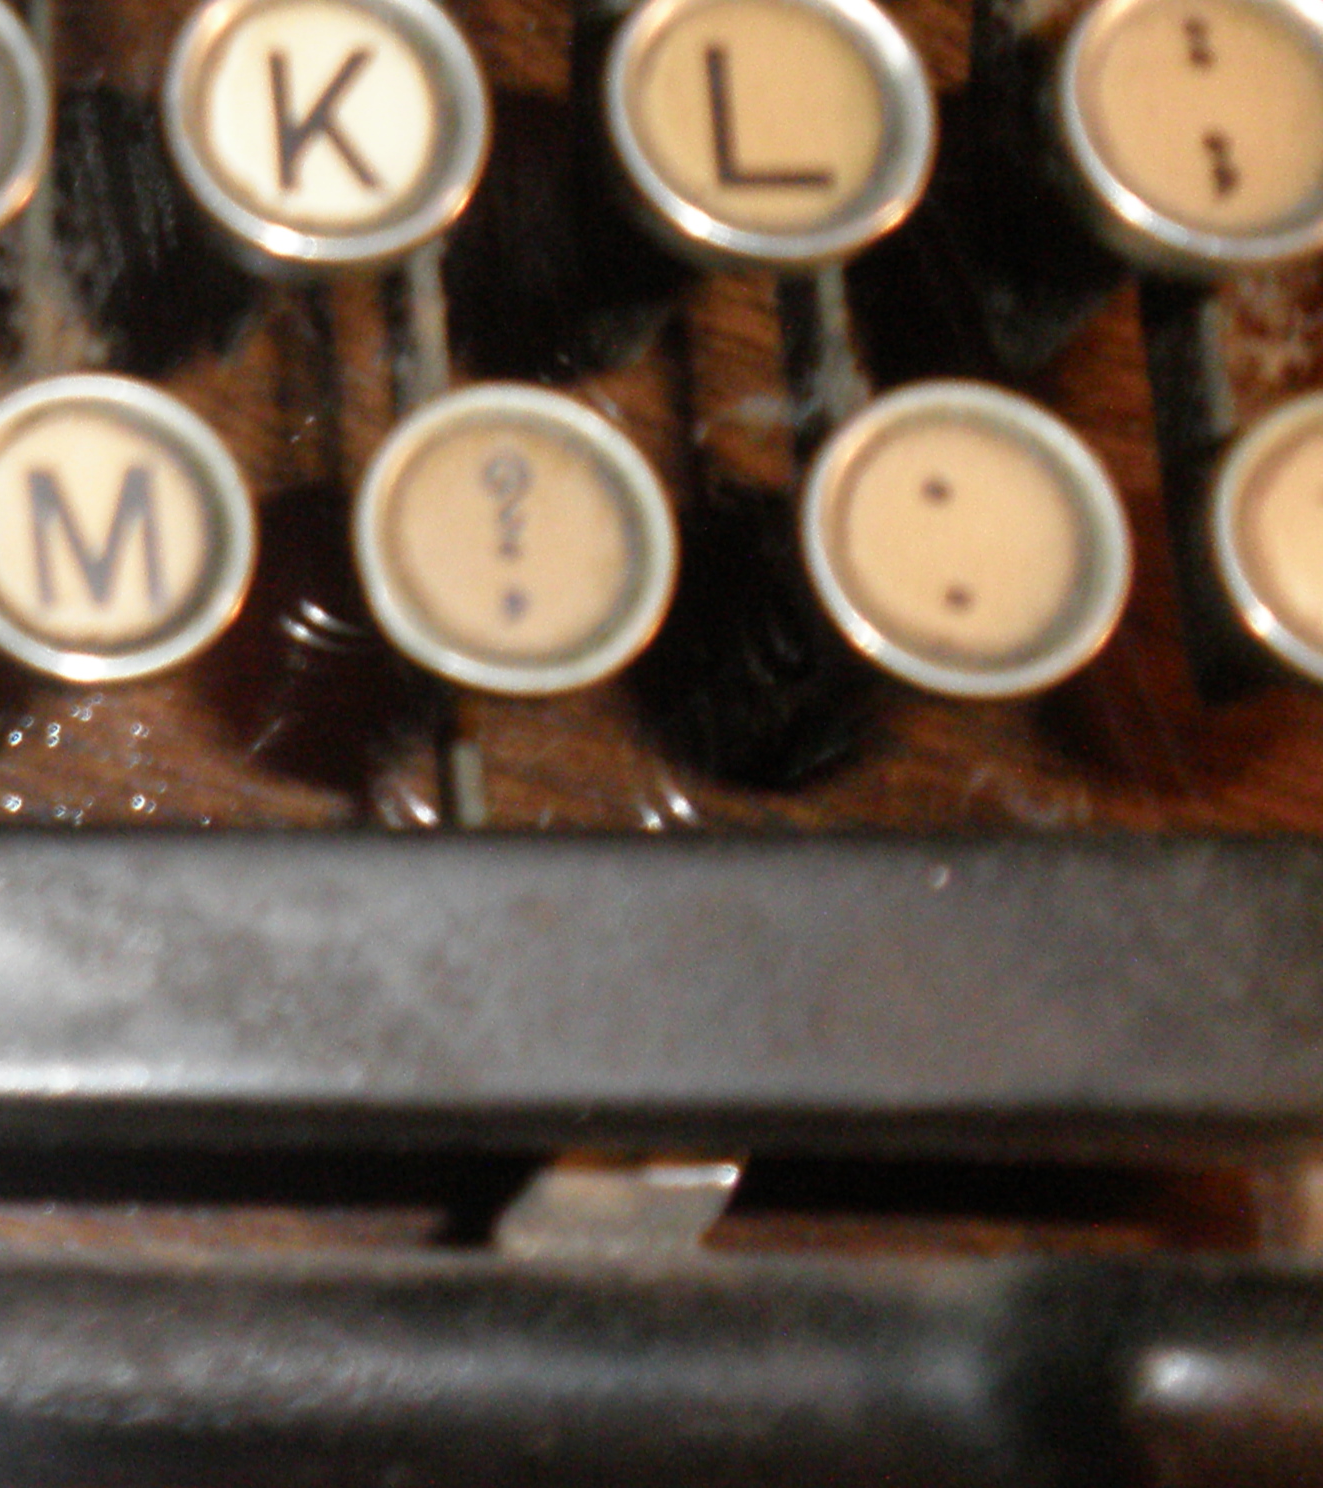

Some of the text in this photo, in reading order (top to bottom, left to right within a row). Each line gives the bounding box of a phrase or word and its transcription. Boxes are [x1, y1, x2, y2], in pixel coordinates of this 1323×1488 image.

[267, 45, 381, 194] K
[702, 42, 835, 190] L
[24, 463, 171, 613] M
